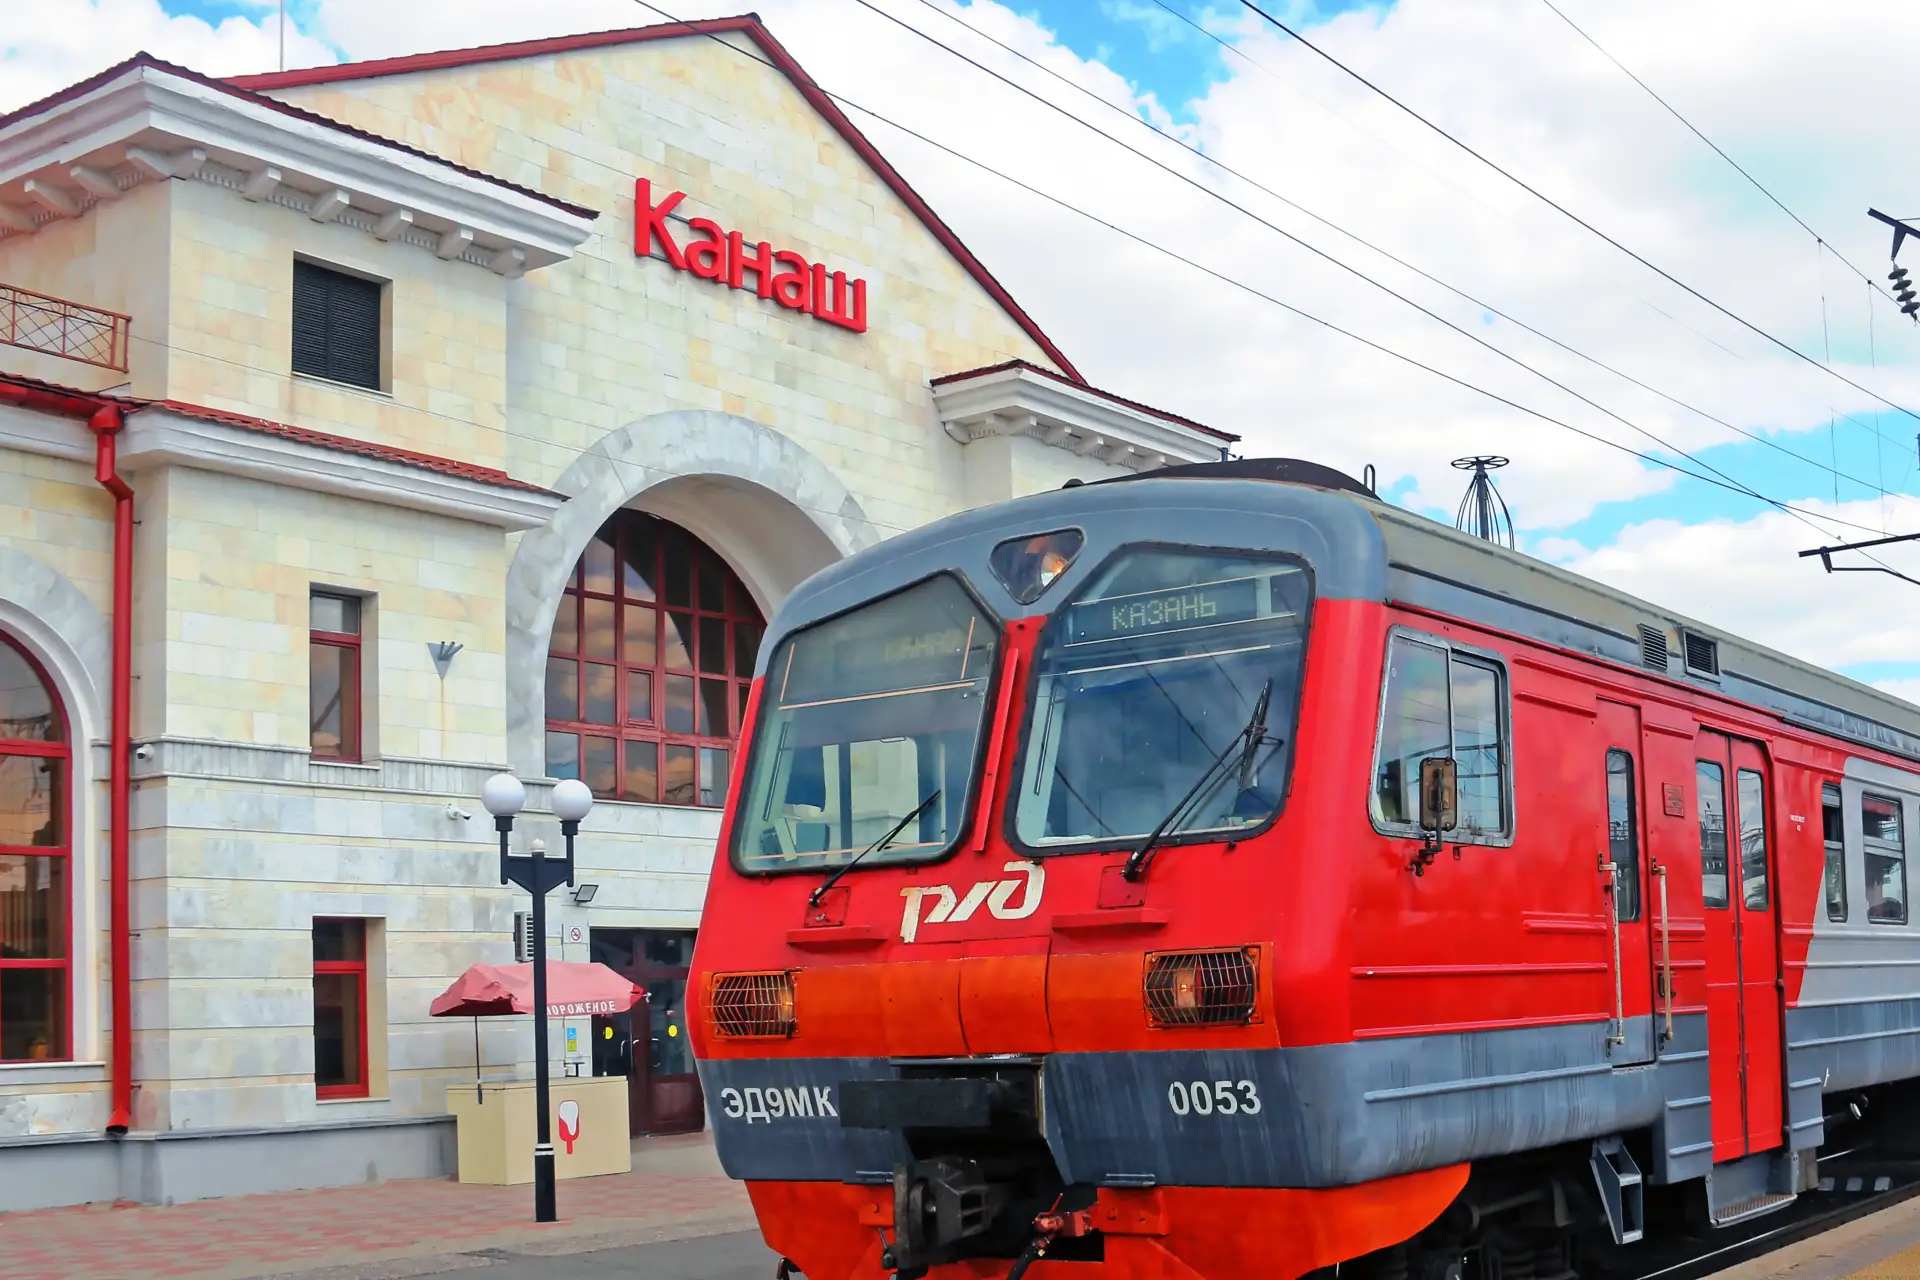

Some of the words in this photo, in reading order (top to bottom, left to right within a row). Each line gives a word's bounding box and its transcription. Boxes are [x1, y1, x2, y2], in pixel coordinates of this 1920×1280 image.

[635, 178, 866, 332] Канаш
[1112, 593, 1216, 630] КАЗАНЬ
[721, 1086, 838, 1124] ЭД9МК
[1168, 1080, 1261, 1115] 0053
